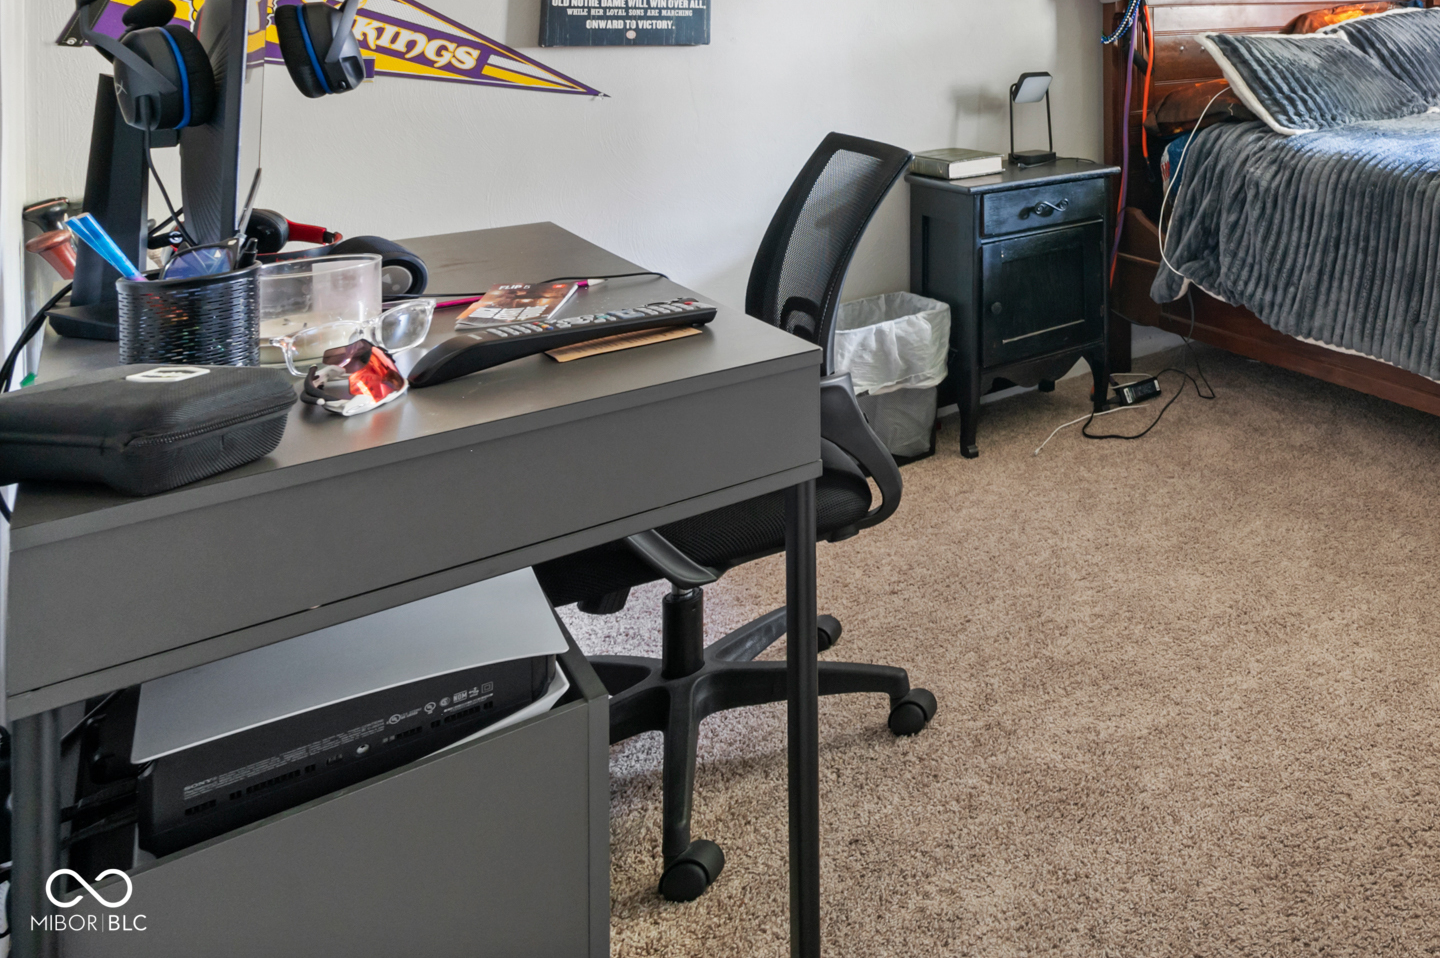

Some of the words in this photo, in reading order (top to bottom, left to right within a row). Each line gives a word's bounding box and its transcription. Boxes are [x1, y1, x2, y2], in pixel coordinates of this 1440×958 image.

[628, 0, 648, 8] WILL
[650, 0, 667, 8] WIN
[668, 0, 689, 9] OVER
[586, 20, 624, 29] ONWARD
[625, 20, 637, 29] TO
[638, 20, 676, 30] VICTORY.
